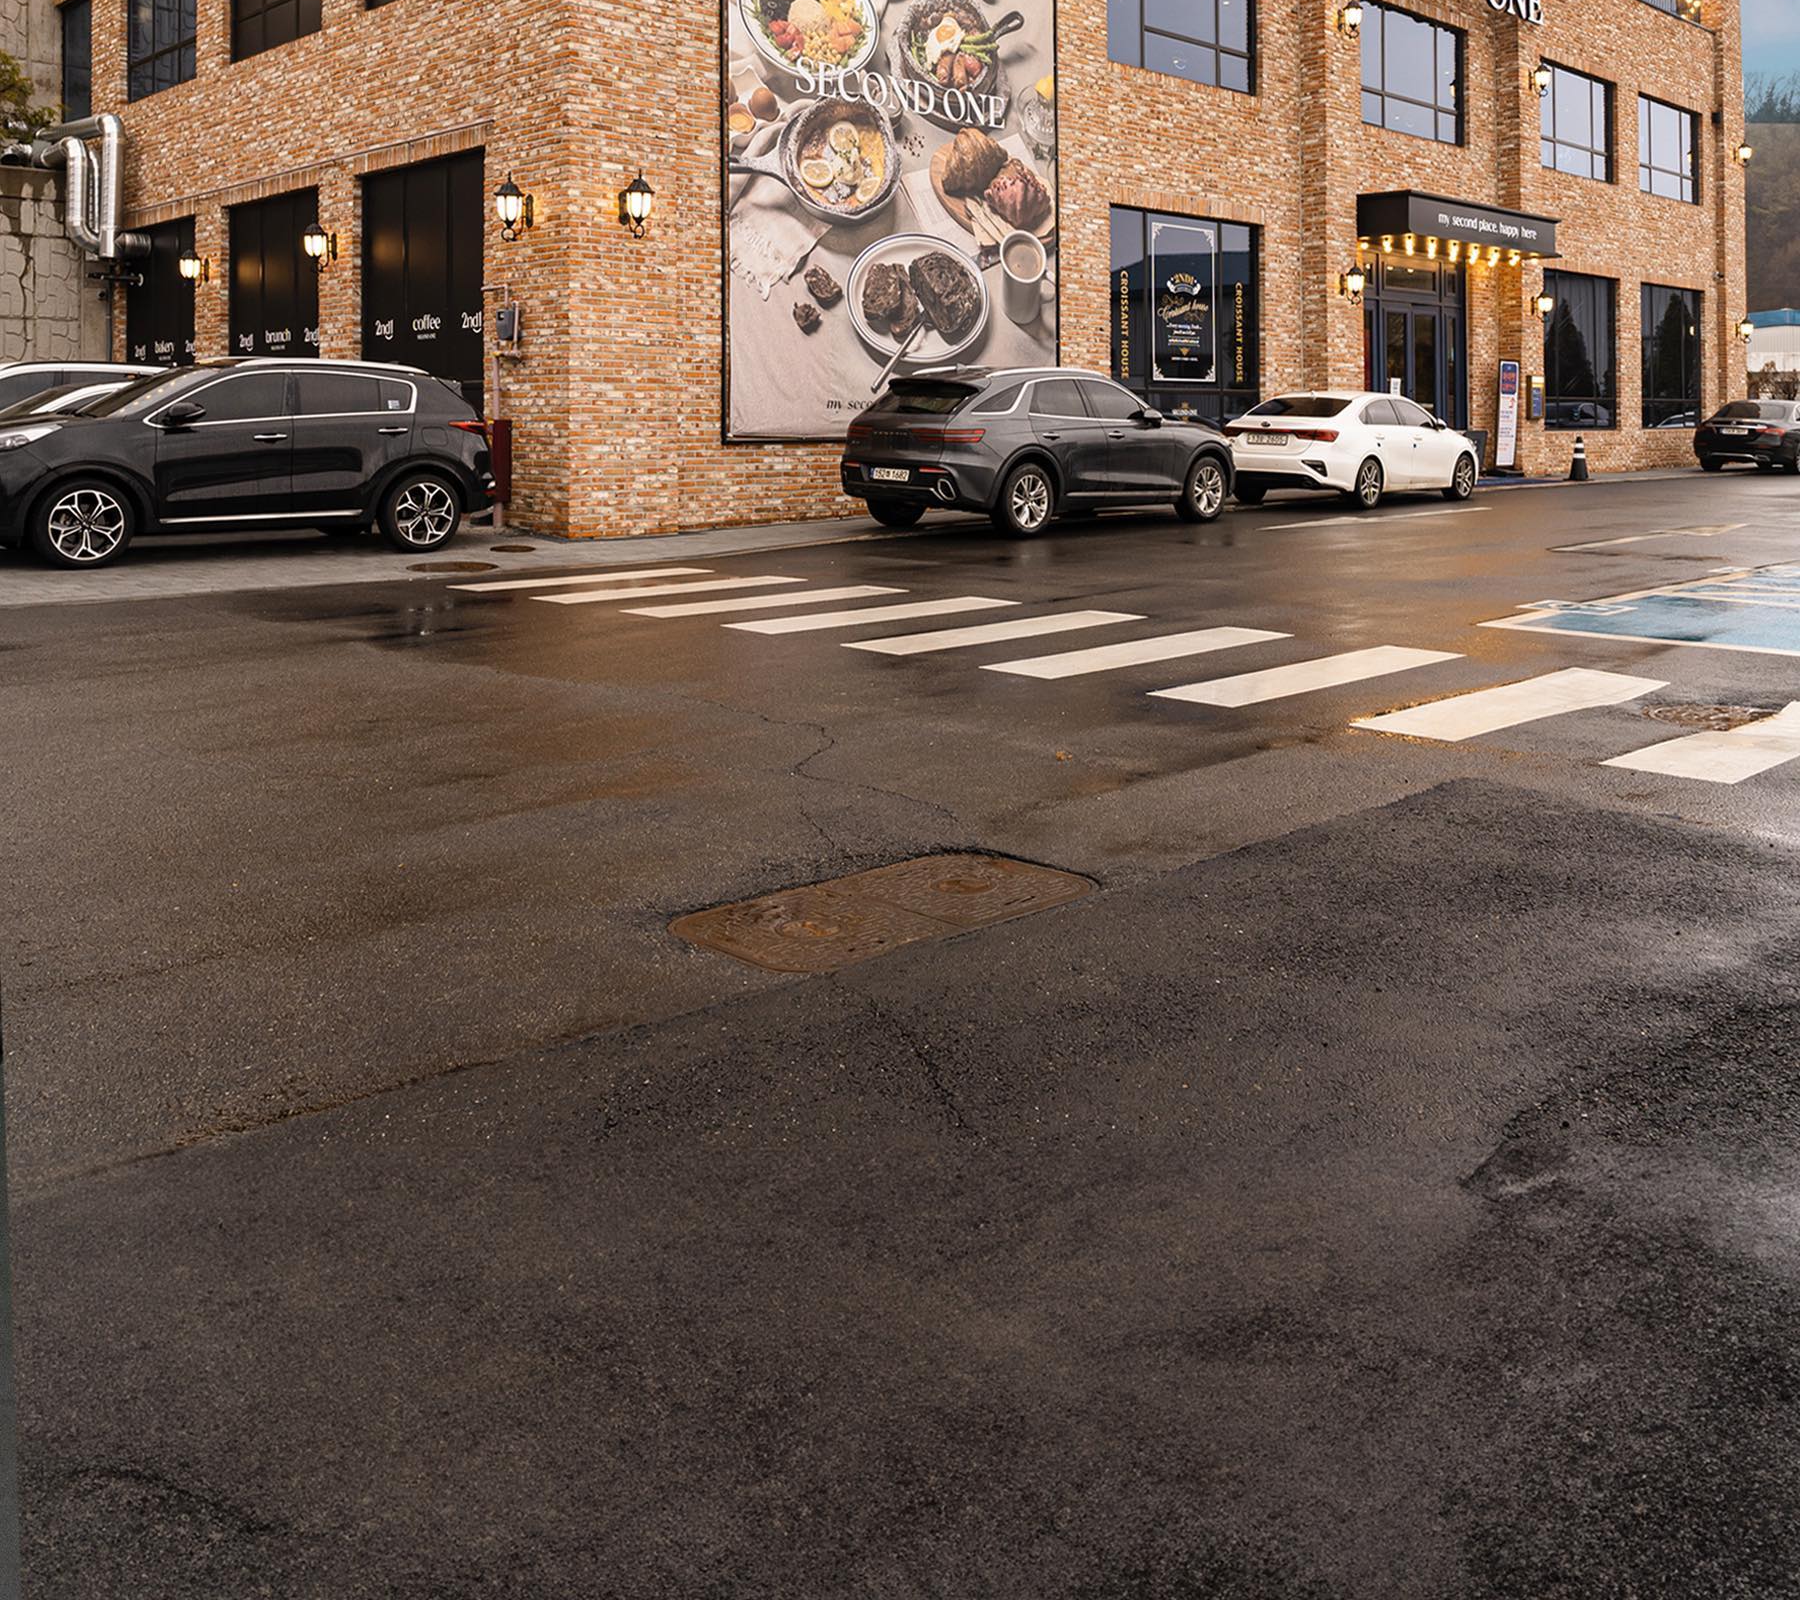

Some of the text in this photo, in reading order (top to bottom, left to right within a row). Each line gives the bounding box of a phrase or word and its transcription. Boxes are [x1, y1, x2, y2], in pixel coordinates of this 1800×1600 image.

[795, 56, 1006, 129] SECOND ONE
[1437, 212, 1451, 228] my
[1451, 215, 1478, 231] second
[1499, 221, 1520, 239] happy
[1520, 225, 1538, 240] here
[264, 328, 292, 344] brunch
[412, 314, 441, 331] coffee
[1120, 269, 1130, 381] CROISSANT HOUSE
[1234, 281, 1244, 383] CROISSANT HOUSE
[826, 400, 842, 414] my
